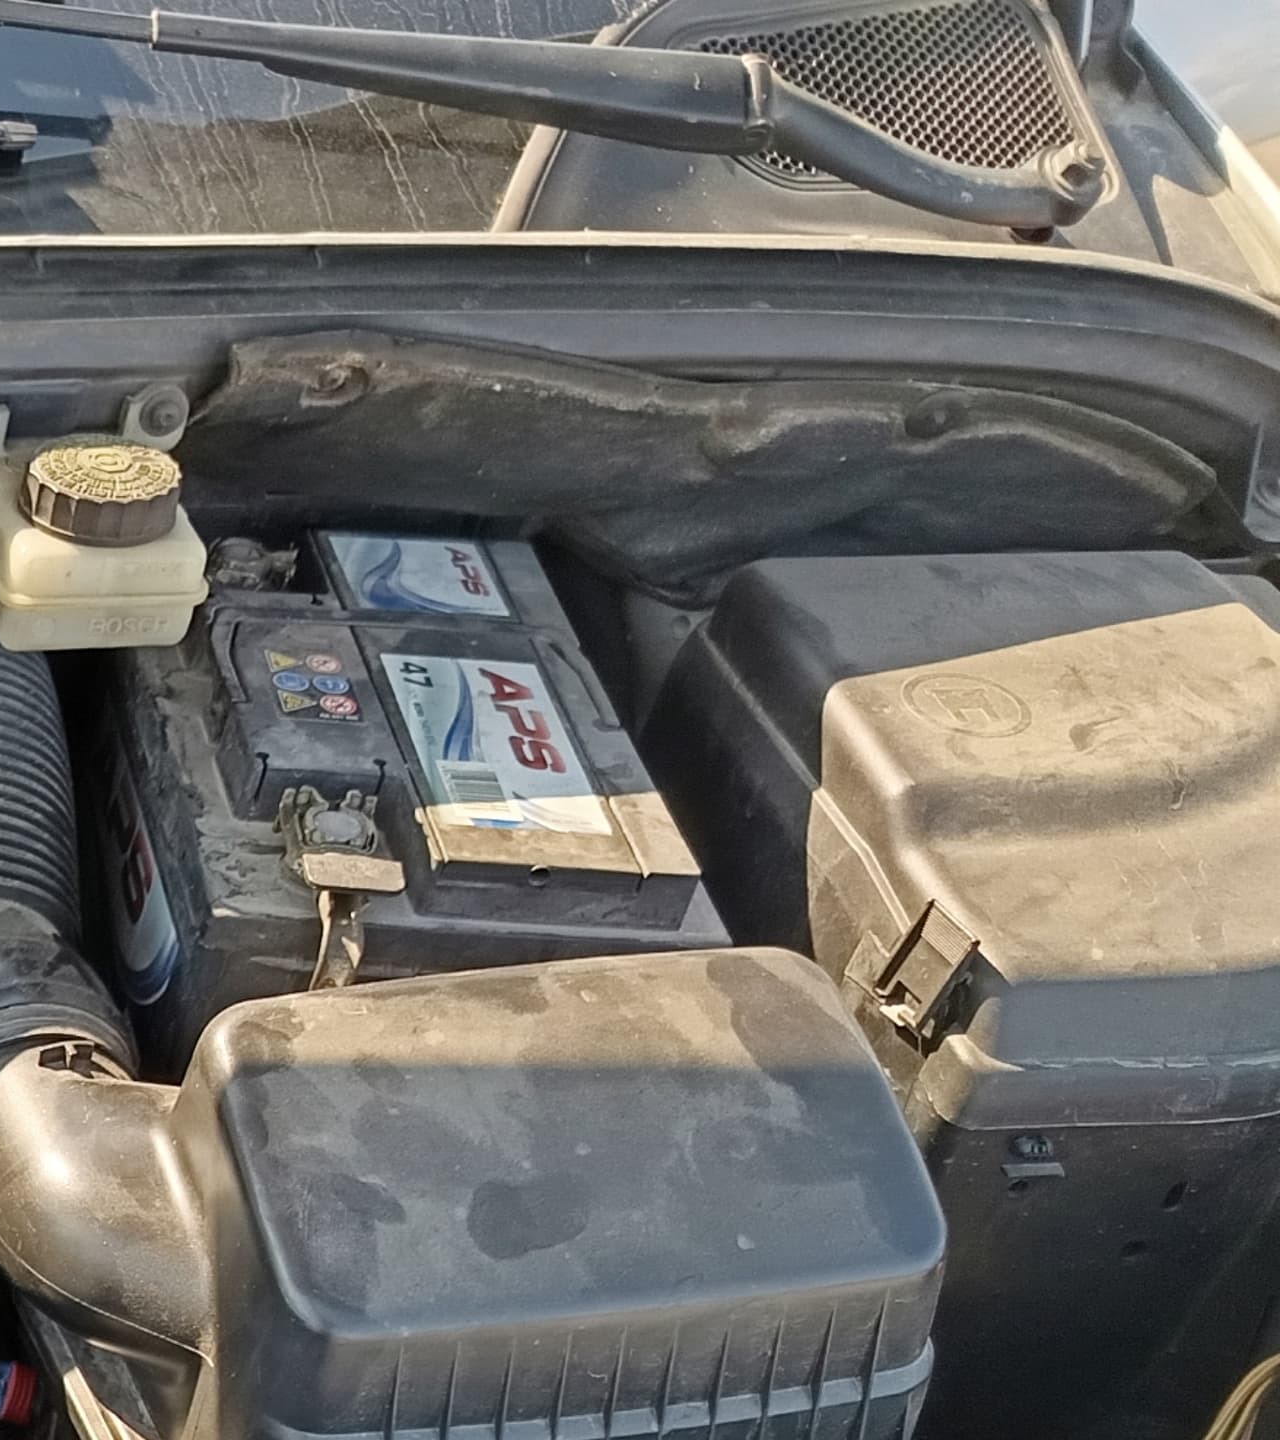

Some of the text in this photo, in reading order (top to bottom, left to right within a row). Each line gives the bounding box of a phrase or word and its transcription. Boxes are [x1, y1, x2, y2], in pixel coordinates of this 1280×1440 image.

[444, 545, 489, 597] APS
[400, 661, 434, 689] 47
[477, 667, 567, 774] APS
